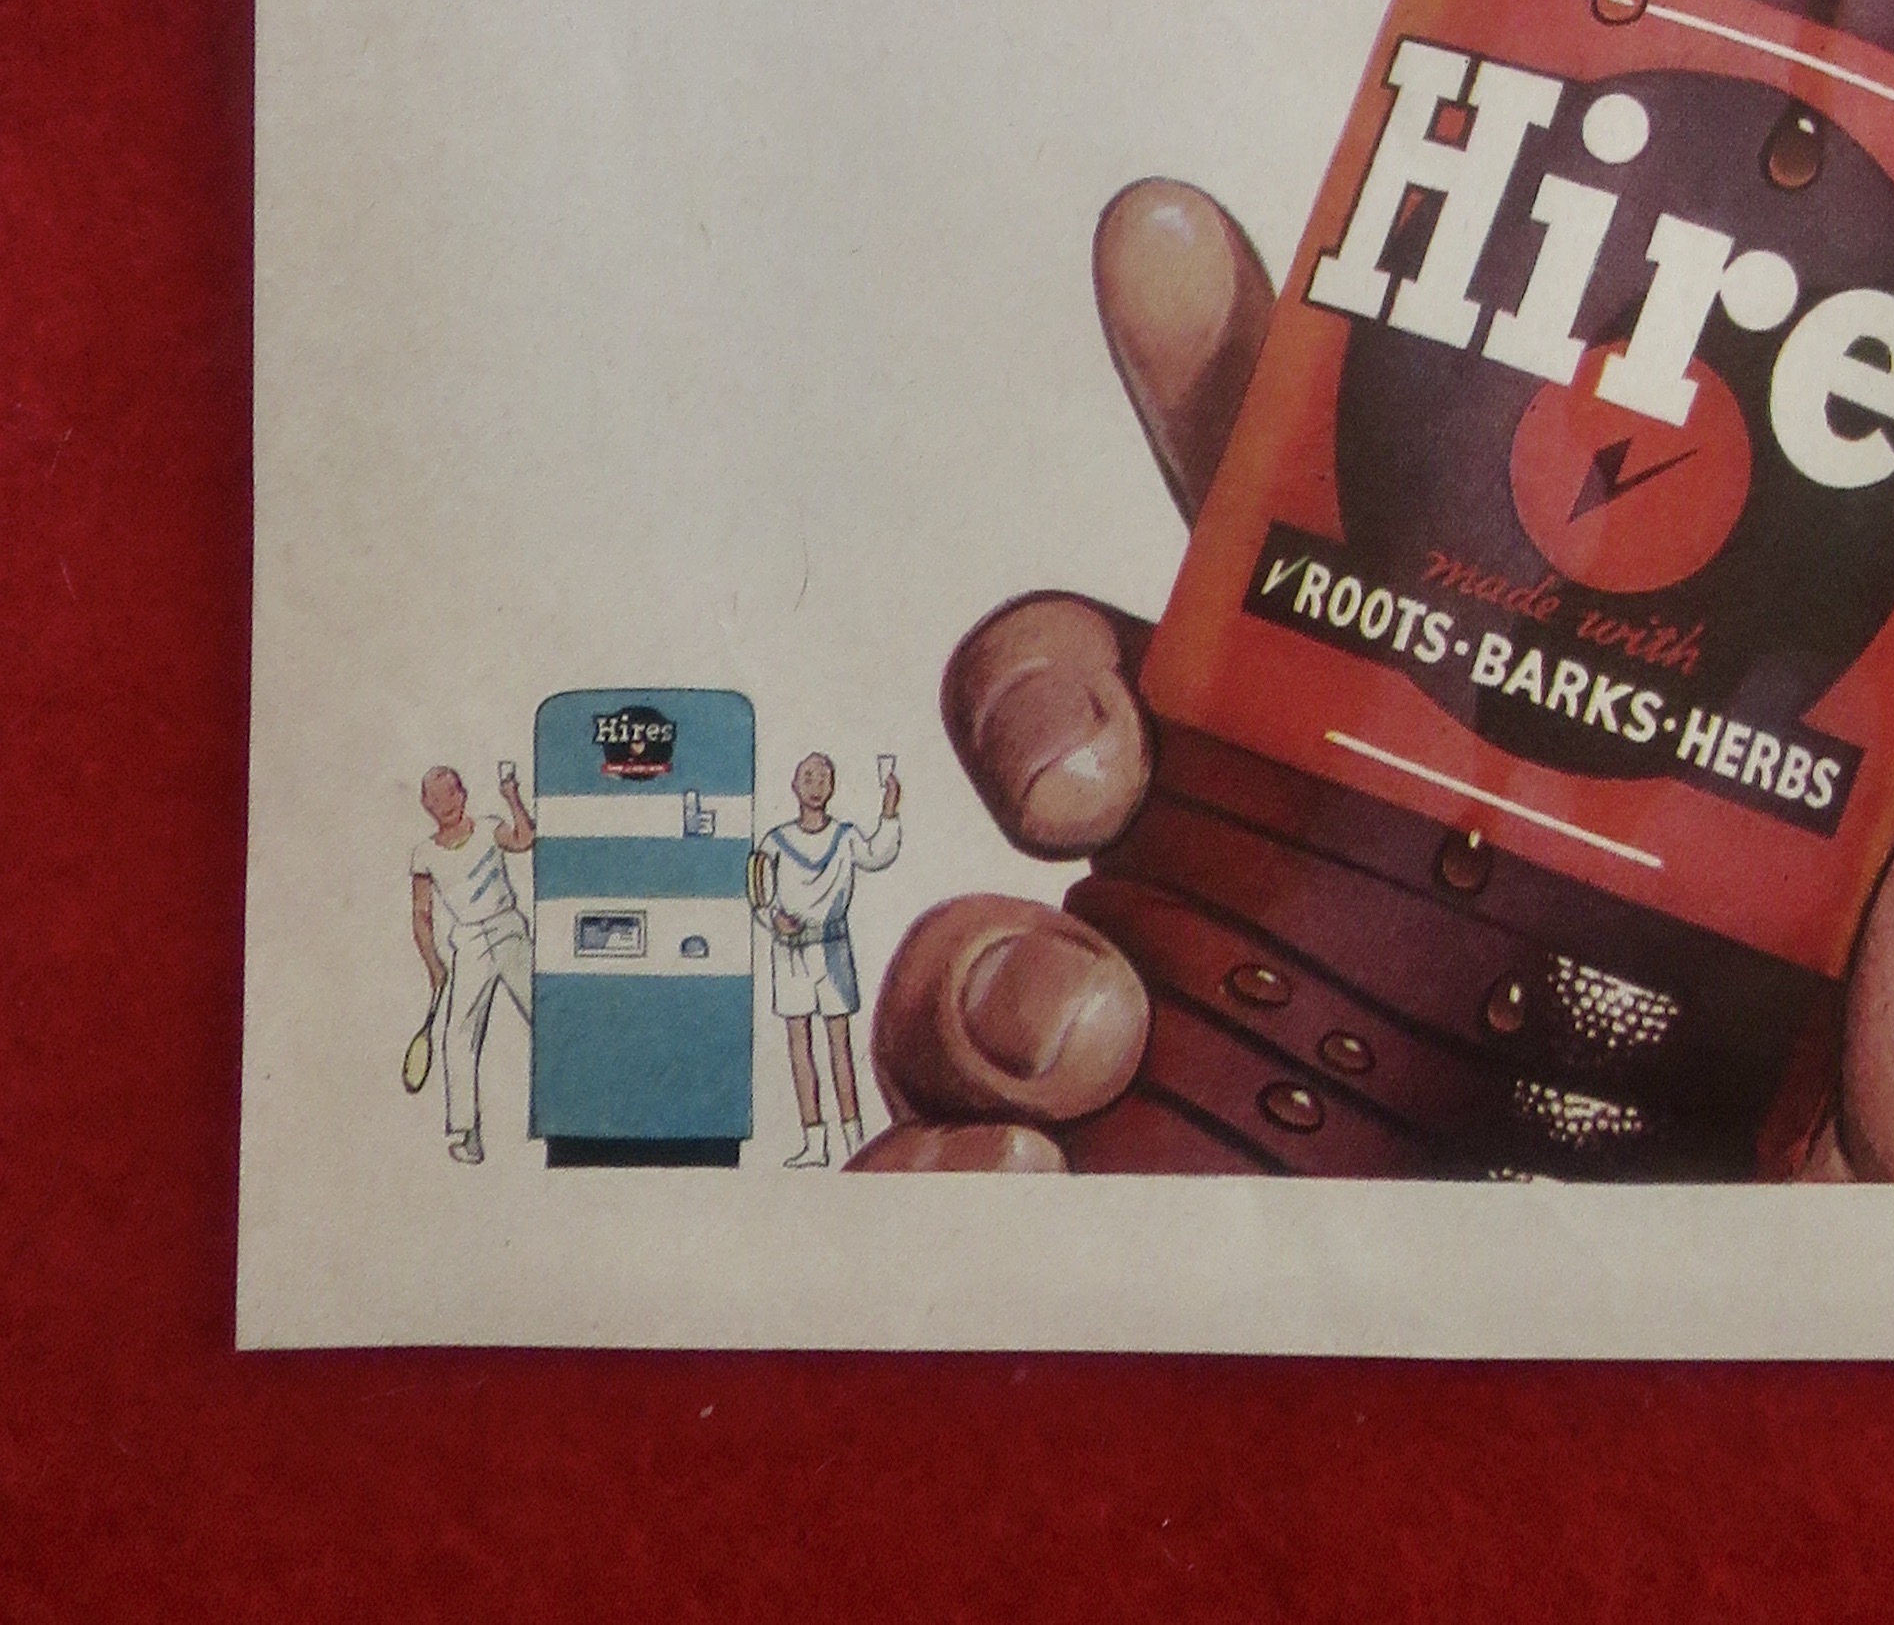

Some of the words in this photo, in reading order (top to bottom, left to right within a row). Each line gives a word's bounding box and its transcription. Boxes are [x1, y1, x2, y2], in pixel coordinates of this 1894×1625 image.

[1422, 549, 1562, 624] made
[1576, 609, 1706, 677] with
[594, 714, 674, 743] Hires
